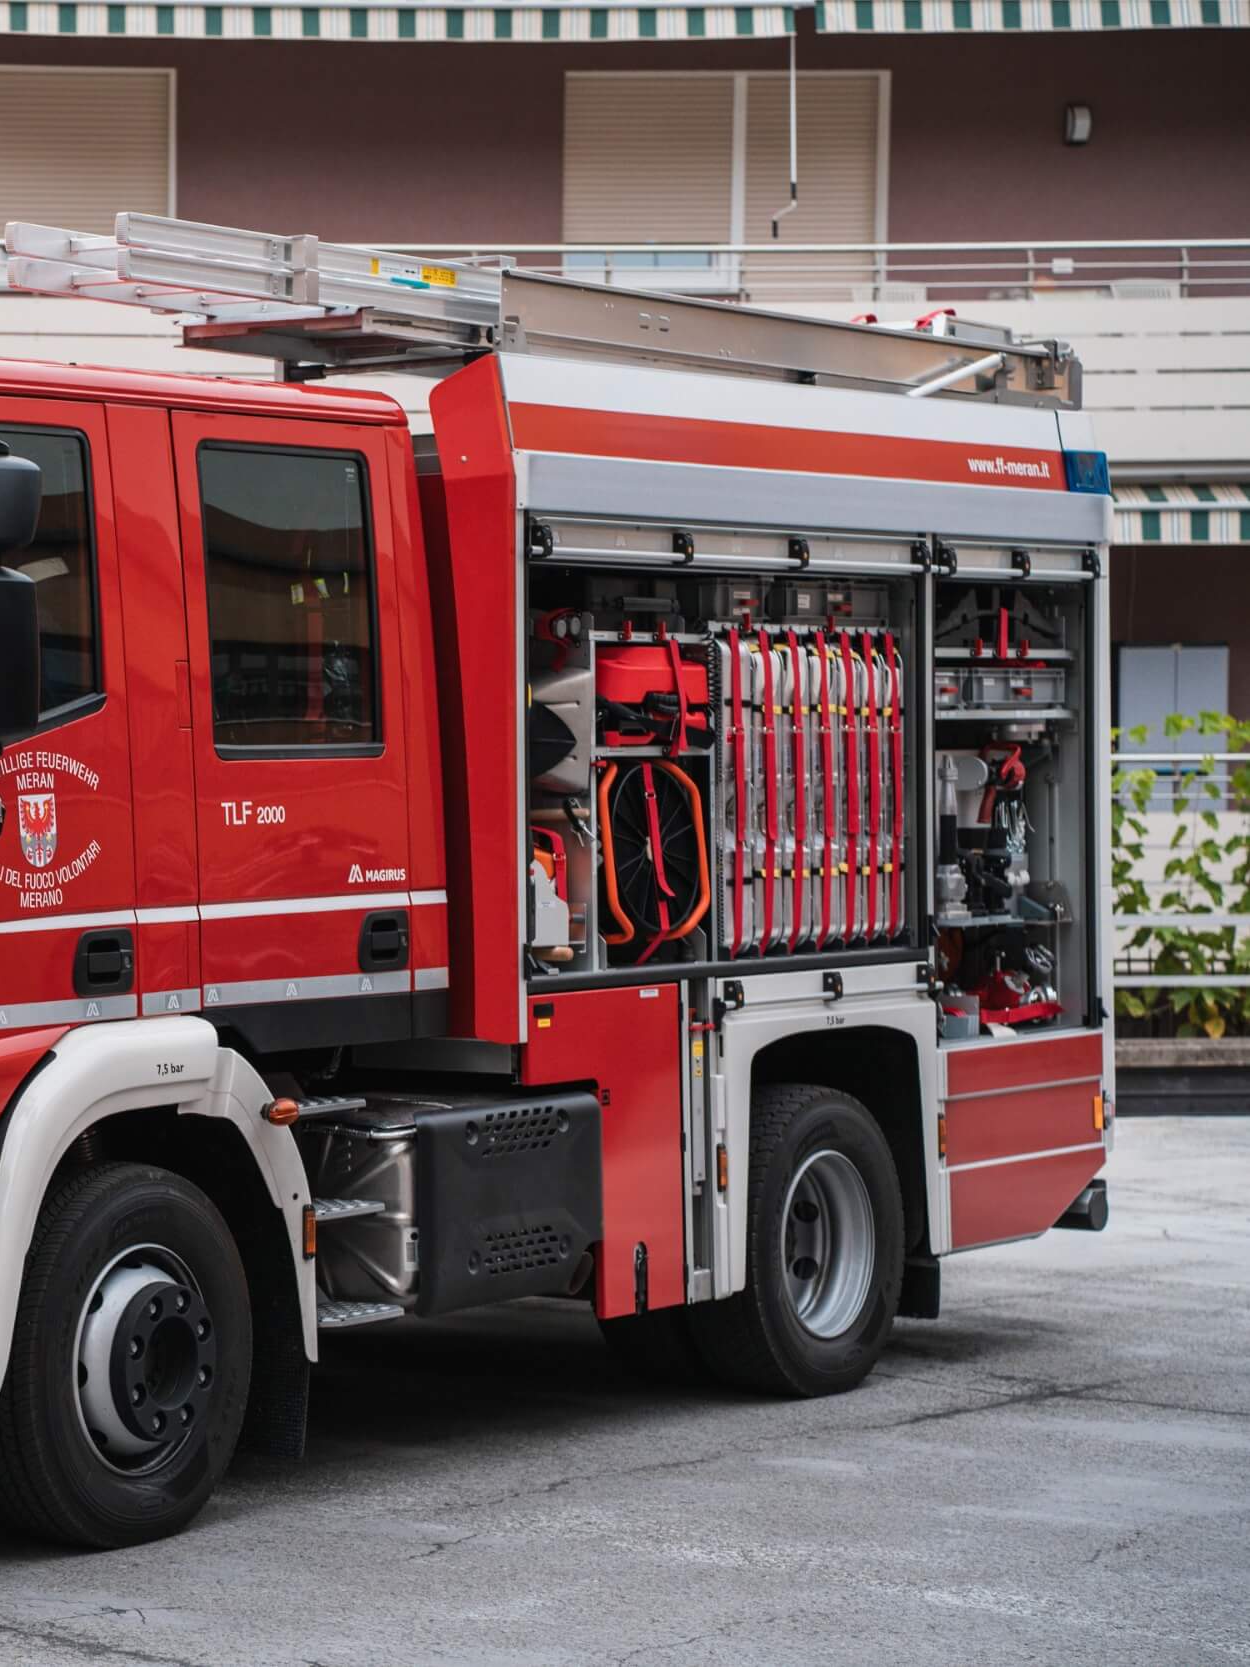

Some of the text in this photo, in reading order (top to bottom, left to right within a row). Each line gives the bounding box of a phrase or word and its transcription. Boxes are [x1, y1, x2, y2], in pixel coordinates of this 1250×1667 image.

[967, 457, 1050, 478] www.ff-meran.it
[16, 773, 55, 791] MERAN
[36, 752, 100, 791] FEUERWEHR
[221, 801, 286, 825] TLF 2000
[5, 868, 22, 889] DEL
[25, 872, 55, 889] FUOCO
[56, 840, 102, 885] VOLONTARI
[365, 868, 406, 882] MAGIRUS
[20, 888, 63, 909] MERANO
[156, 1062, 184, 1076] 7,5 bar
